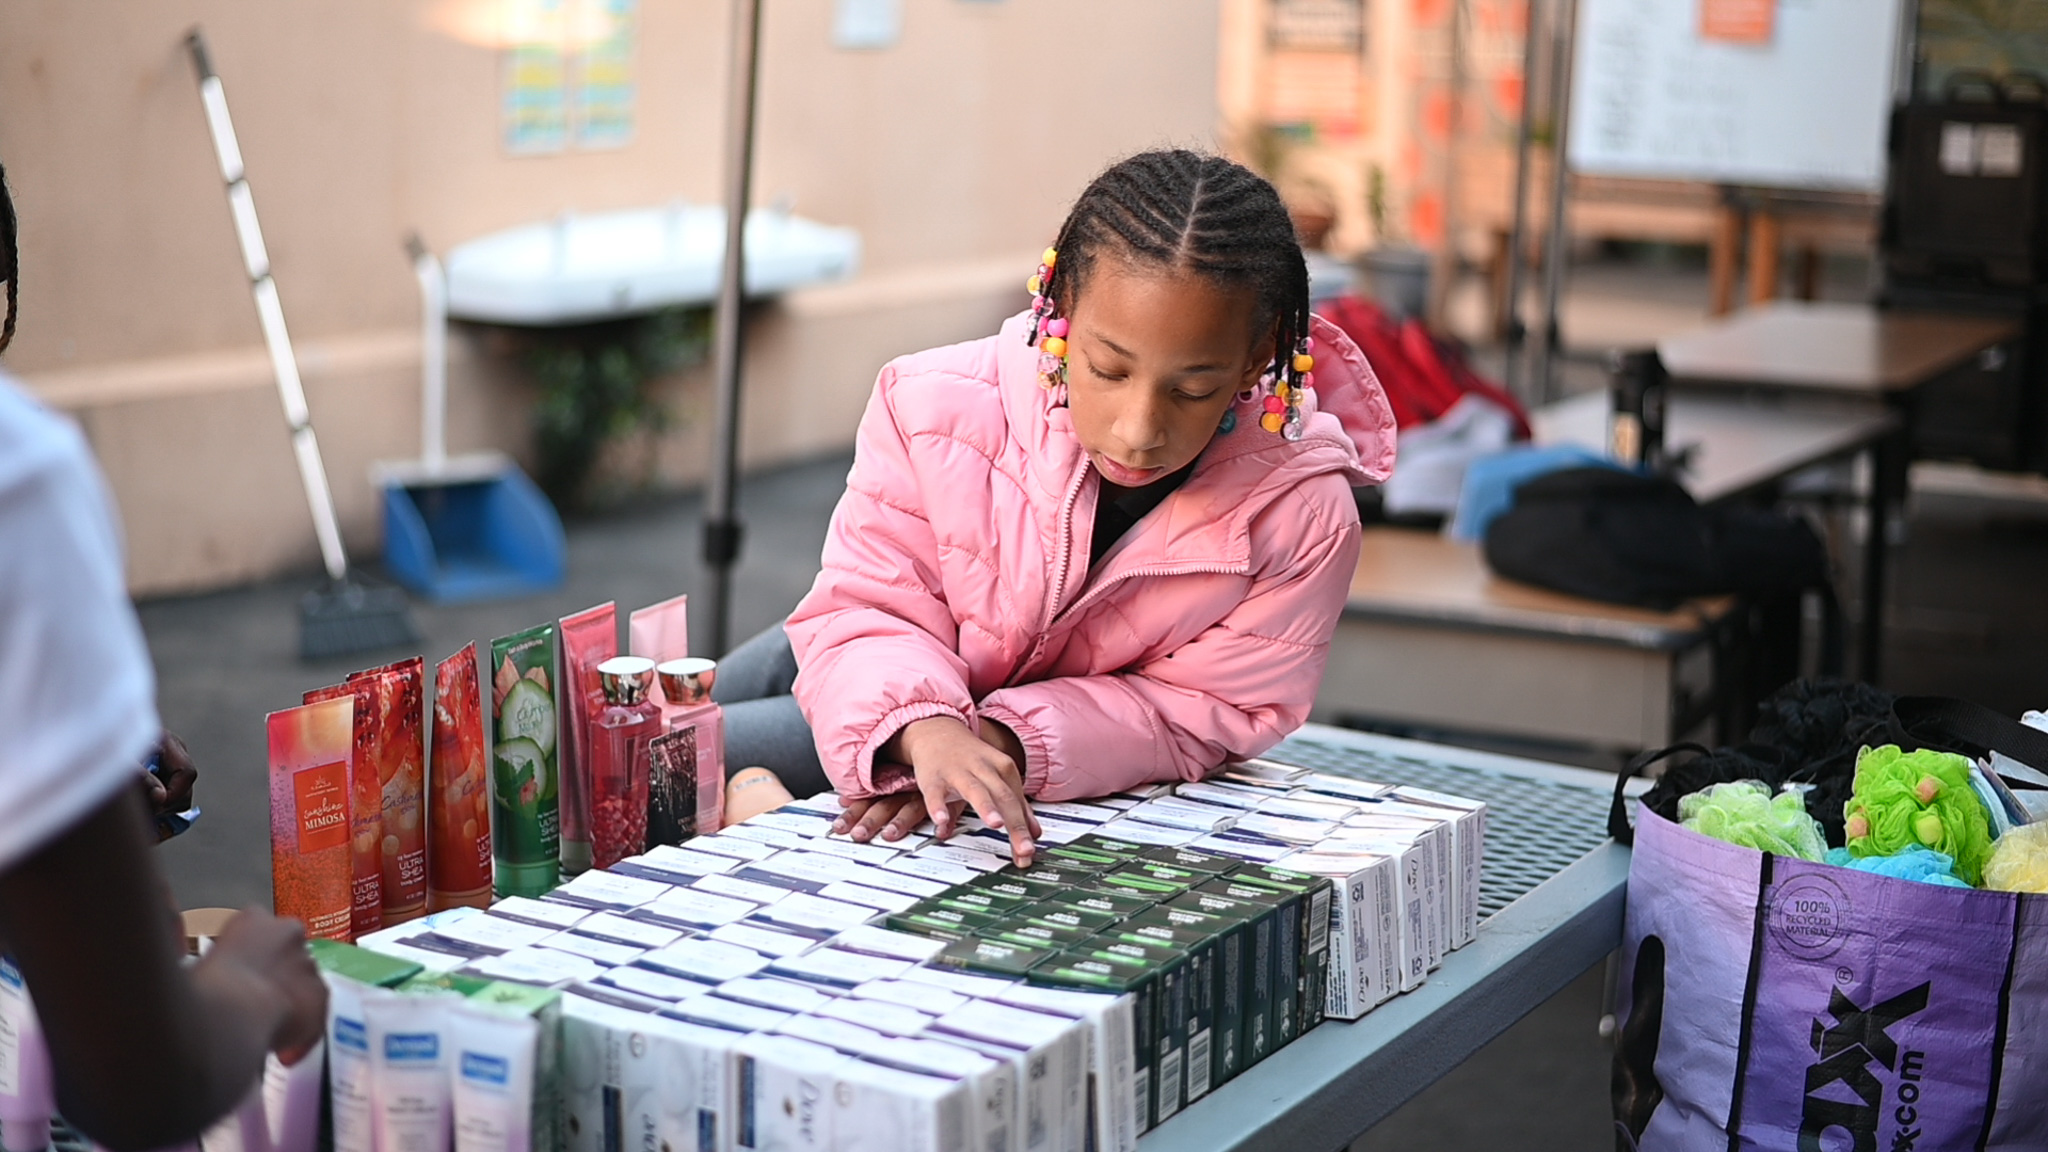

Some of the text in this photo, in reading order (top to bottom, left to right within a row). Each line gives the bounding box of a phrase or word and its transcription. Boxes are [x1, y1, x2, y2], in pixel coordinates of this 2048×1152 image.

[304, 812, 346, 831] MIMOSA
[398, 856, 424, 871] ULTRA
[401, 865, 424, 880] SHEA
[1410, 858, 1419, 894] Dove
[352, 880, 379, 896] ULTRA
[355, 890, 379, 905] SHEA
[1795, 900, 1831, 914] 100%
[1785, 914, 1832, 926] RECYCLED
[1785, 925, 1832, 938] MATERIAL
[1357, 966, 1367, 1003] Dove
